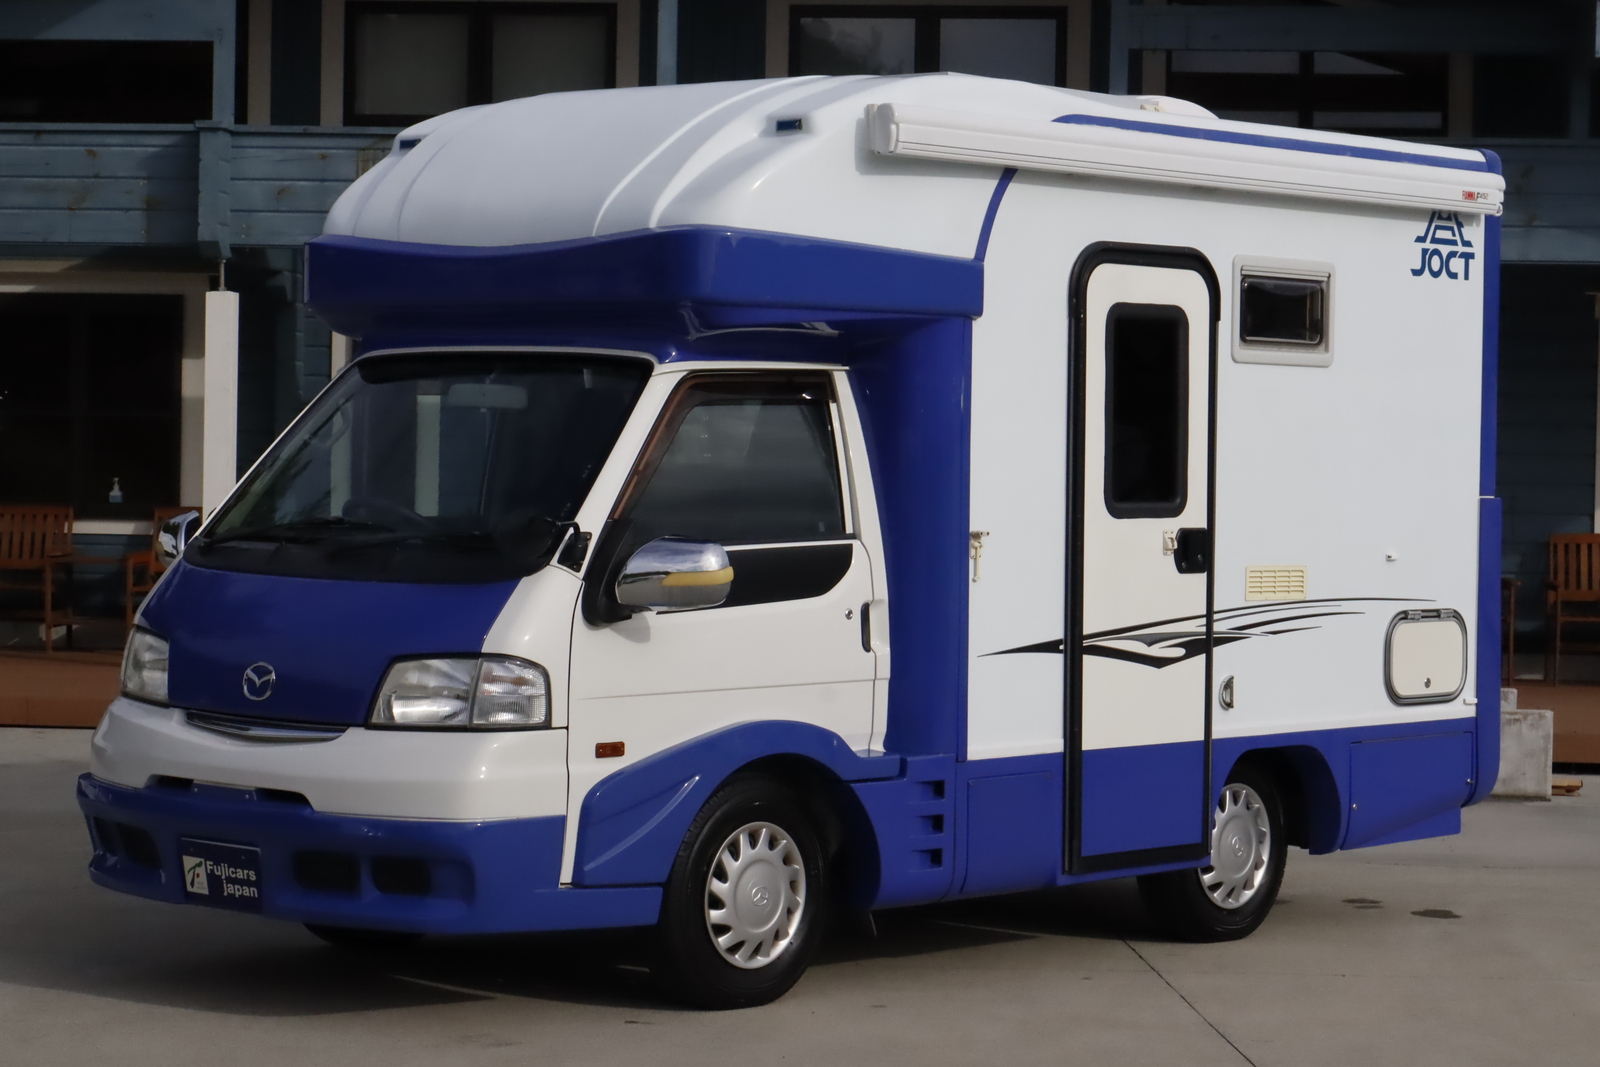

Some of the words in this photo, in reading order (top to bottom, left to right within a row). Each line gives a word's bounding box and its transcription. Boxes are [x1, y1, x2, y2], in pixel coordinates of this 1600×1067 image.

[1410, 247, 1475, 281] JOCT
[206, 860, 256, 881] Fujicars
[223, 880, 258, 898] japan
